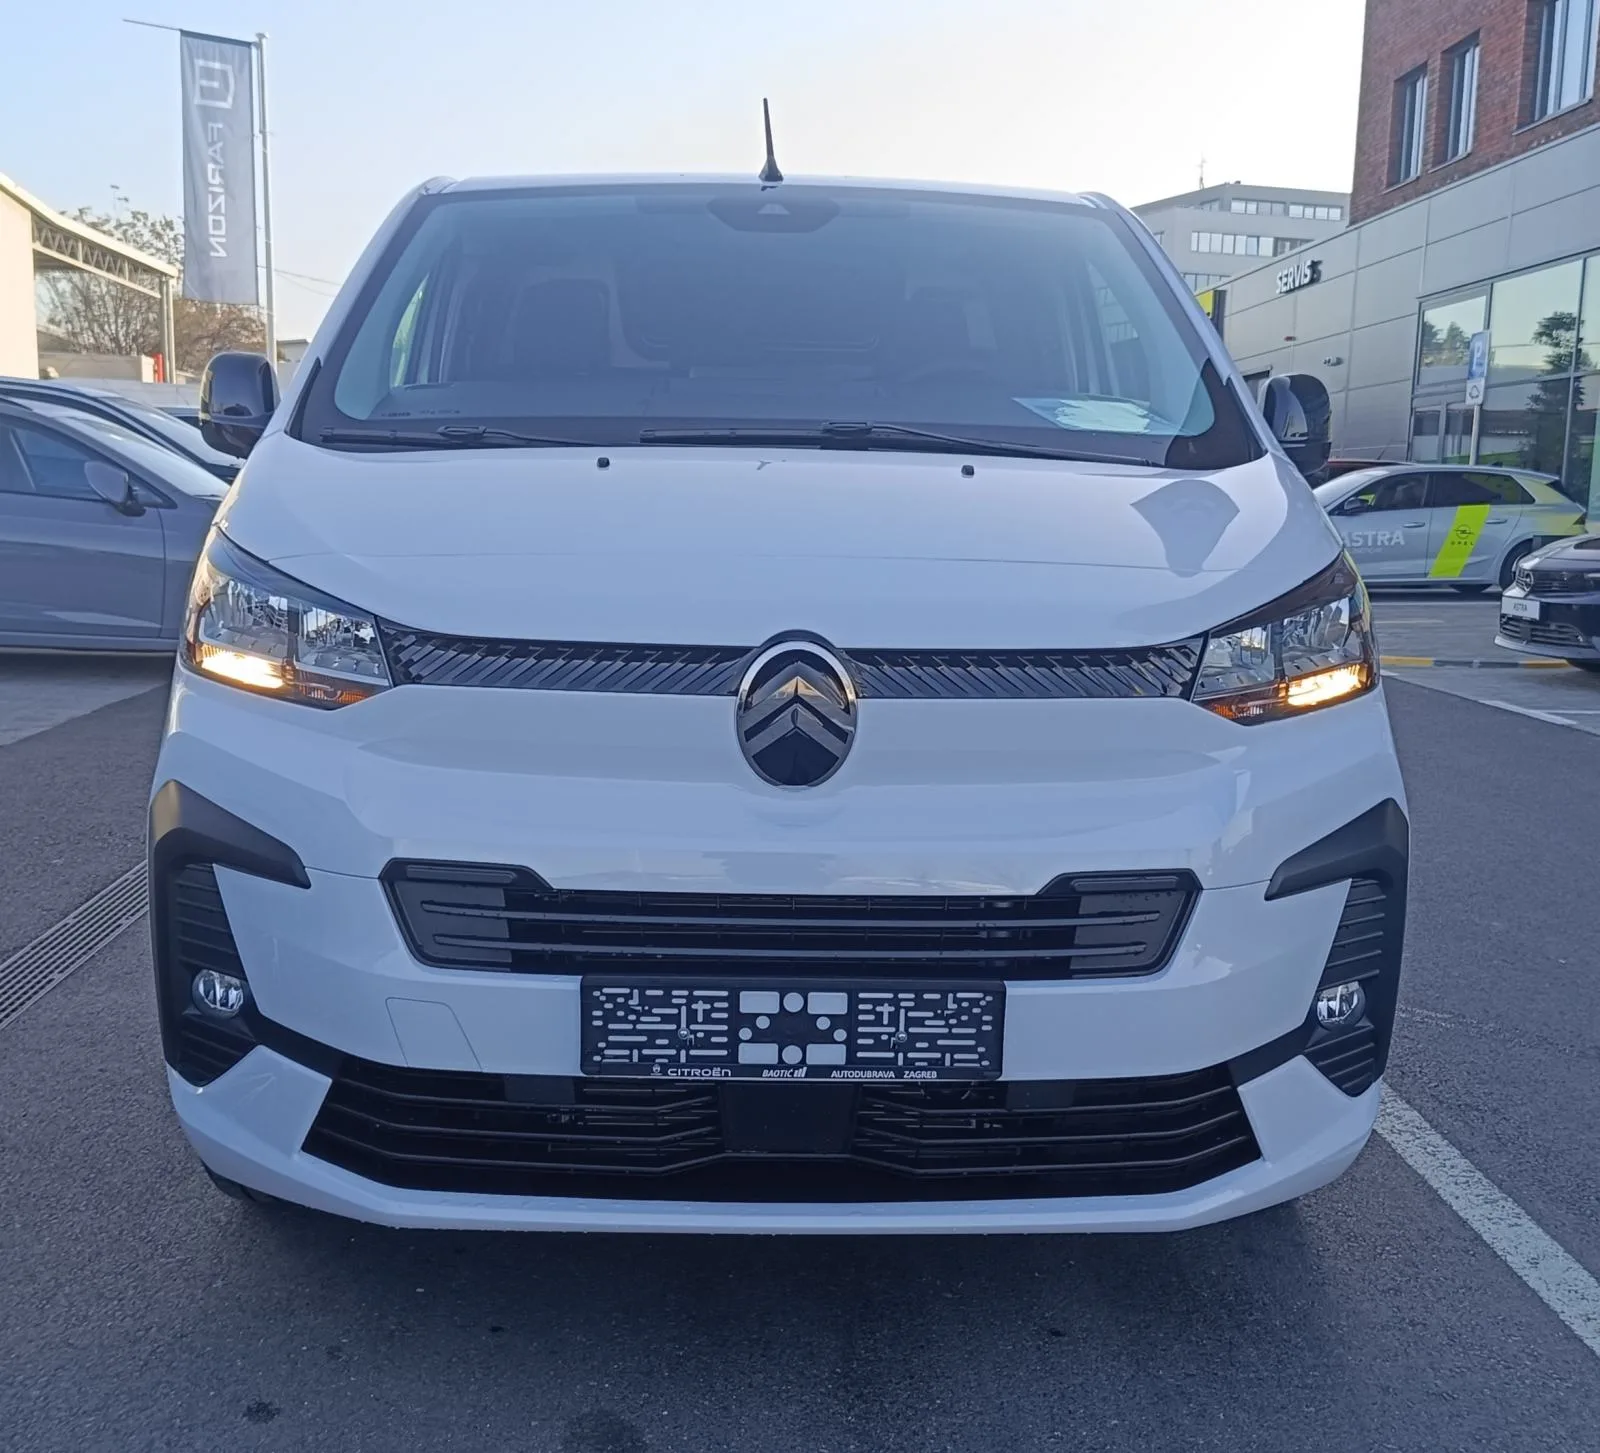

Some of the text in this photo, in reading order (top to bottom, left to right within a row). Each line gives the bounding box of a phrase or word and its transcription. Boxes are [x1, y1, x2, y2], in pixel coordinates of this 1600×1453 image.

[1275, 259, 1311, 294] SERVIS
[830, 1070, 938, 1079] AUTODUBRAVA ZAGREB
